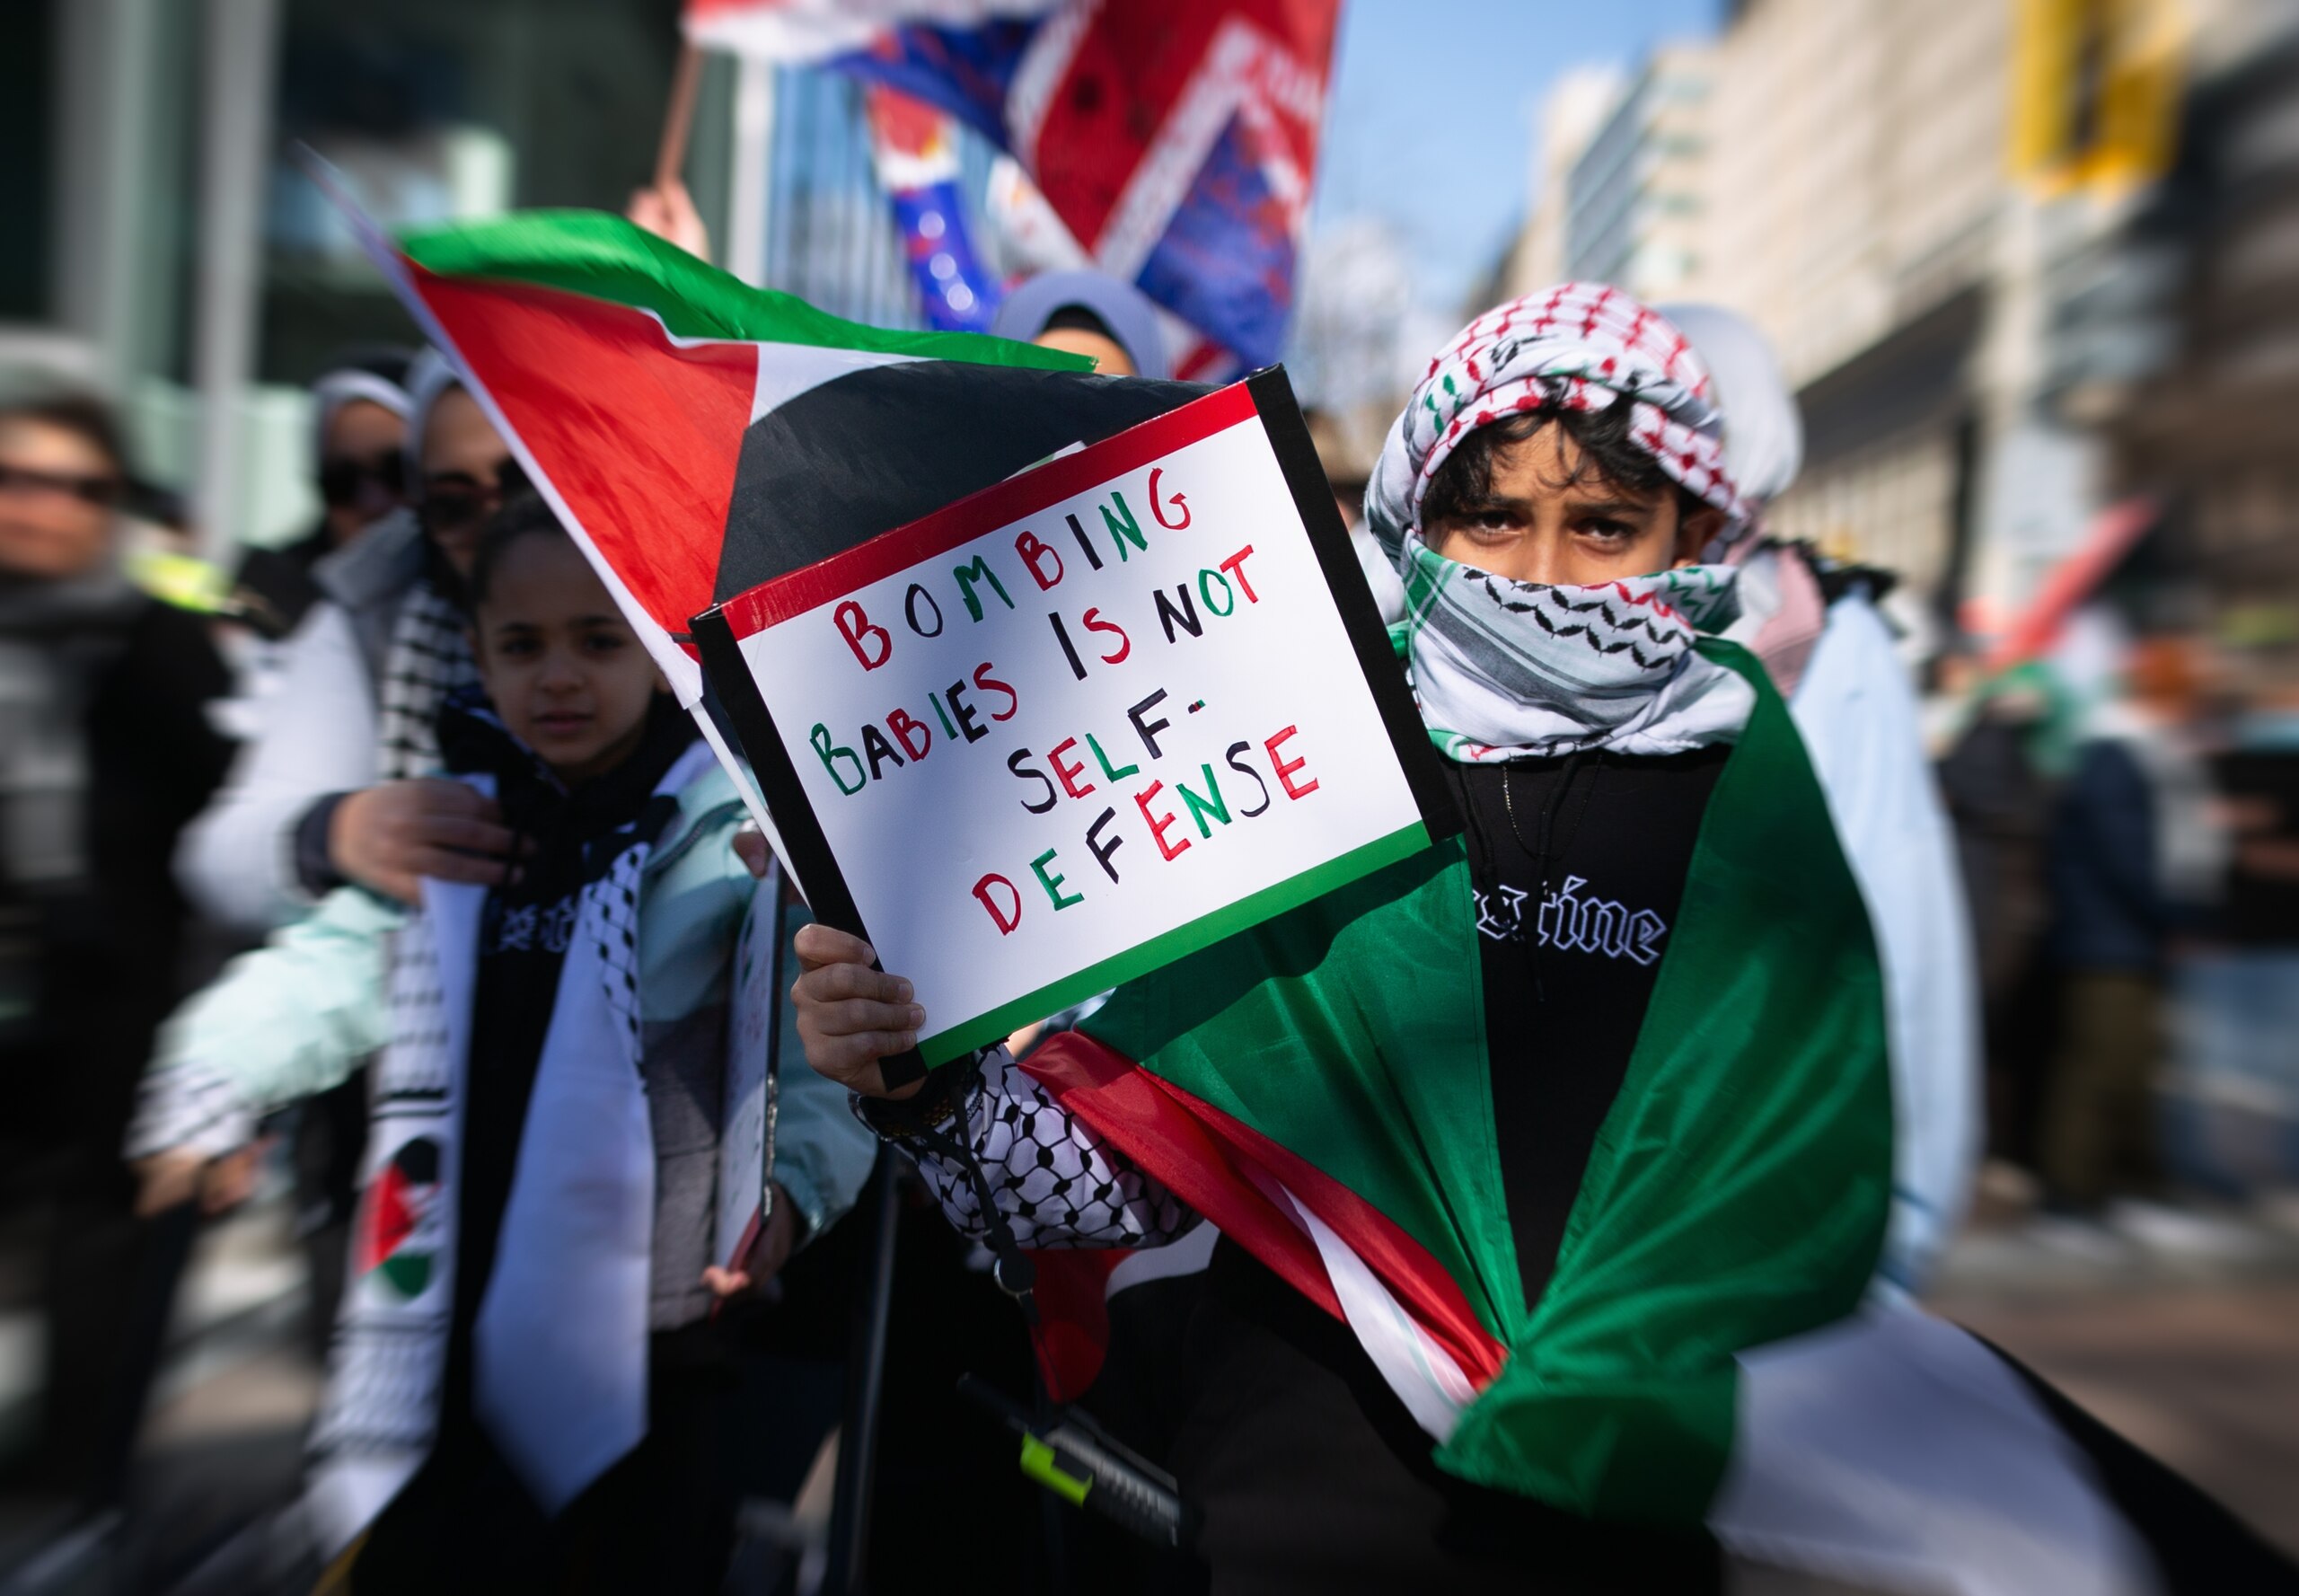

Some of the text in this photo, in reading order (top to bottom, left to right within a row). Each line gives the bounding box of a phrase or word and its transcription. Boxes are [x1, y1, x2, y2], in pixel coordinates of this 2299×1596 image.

[809, 543, 1259, 797] BABIES IS NOT
[832, 467, 1192, 672] BOMBING
[971, 724, 1320, 937] DEFENSE
[1007, 686, 1207, 815] SELF-
